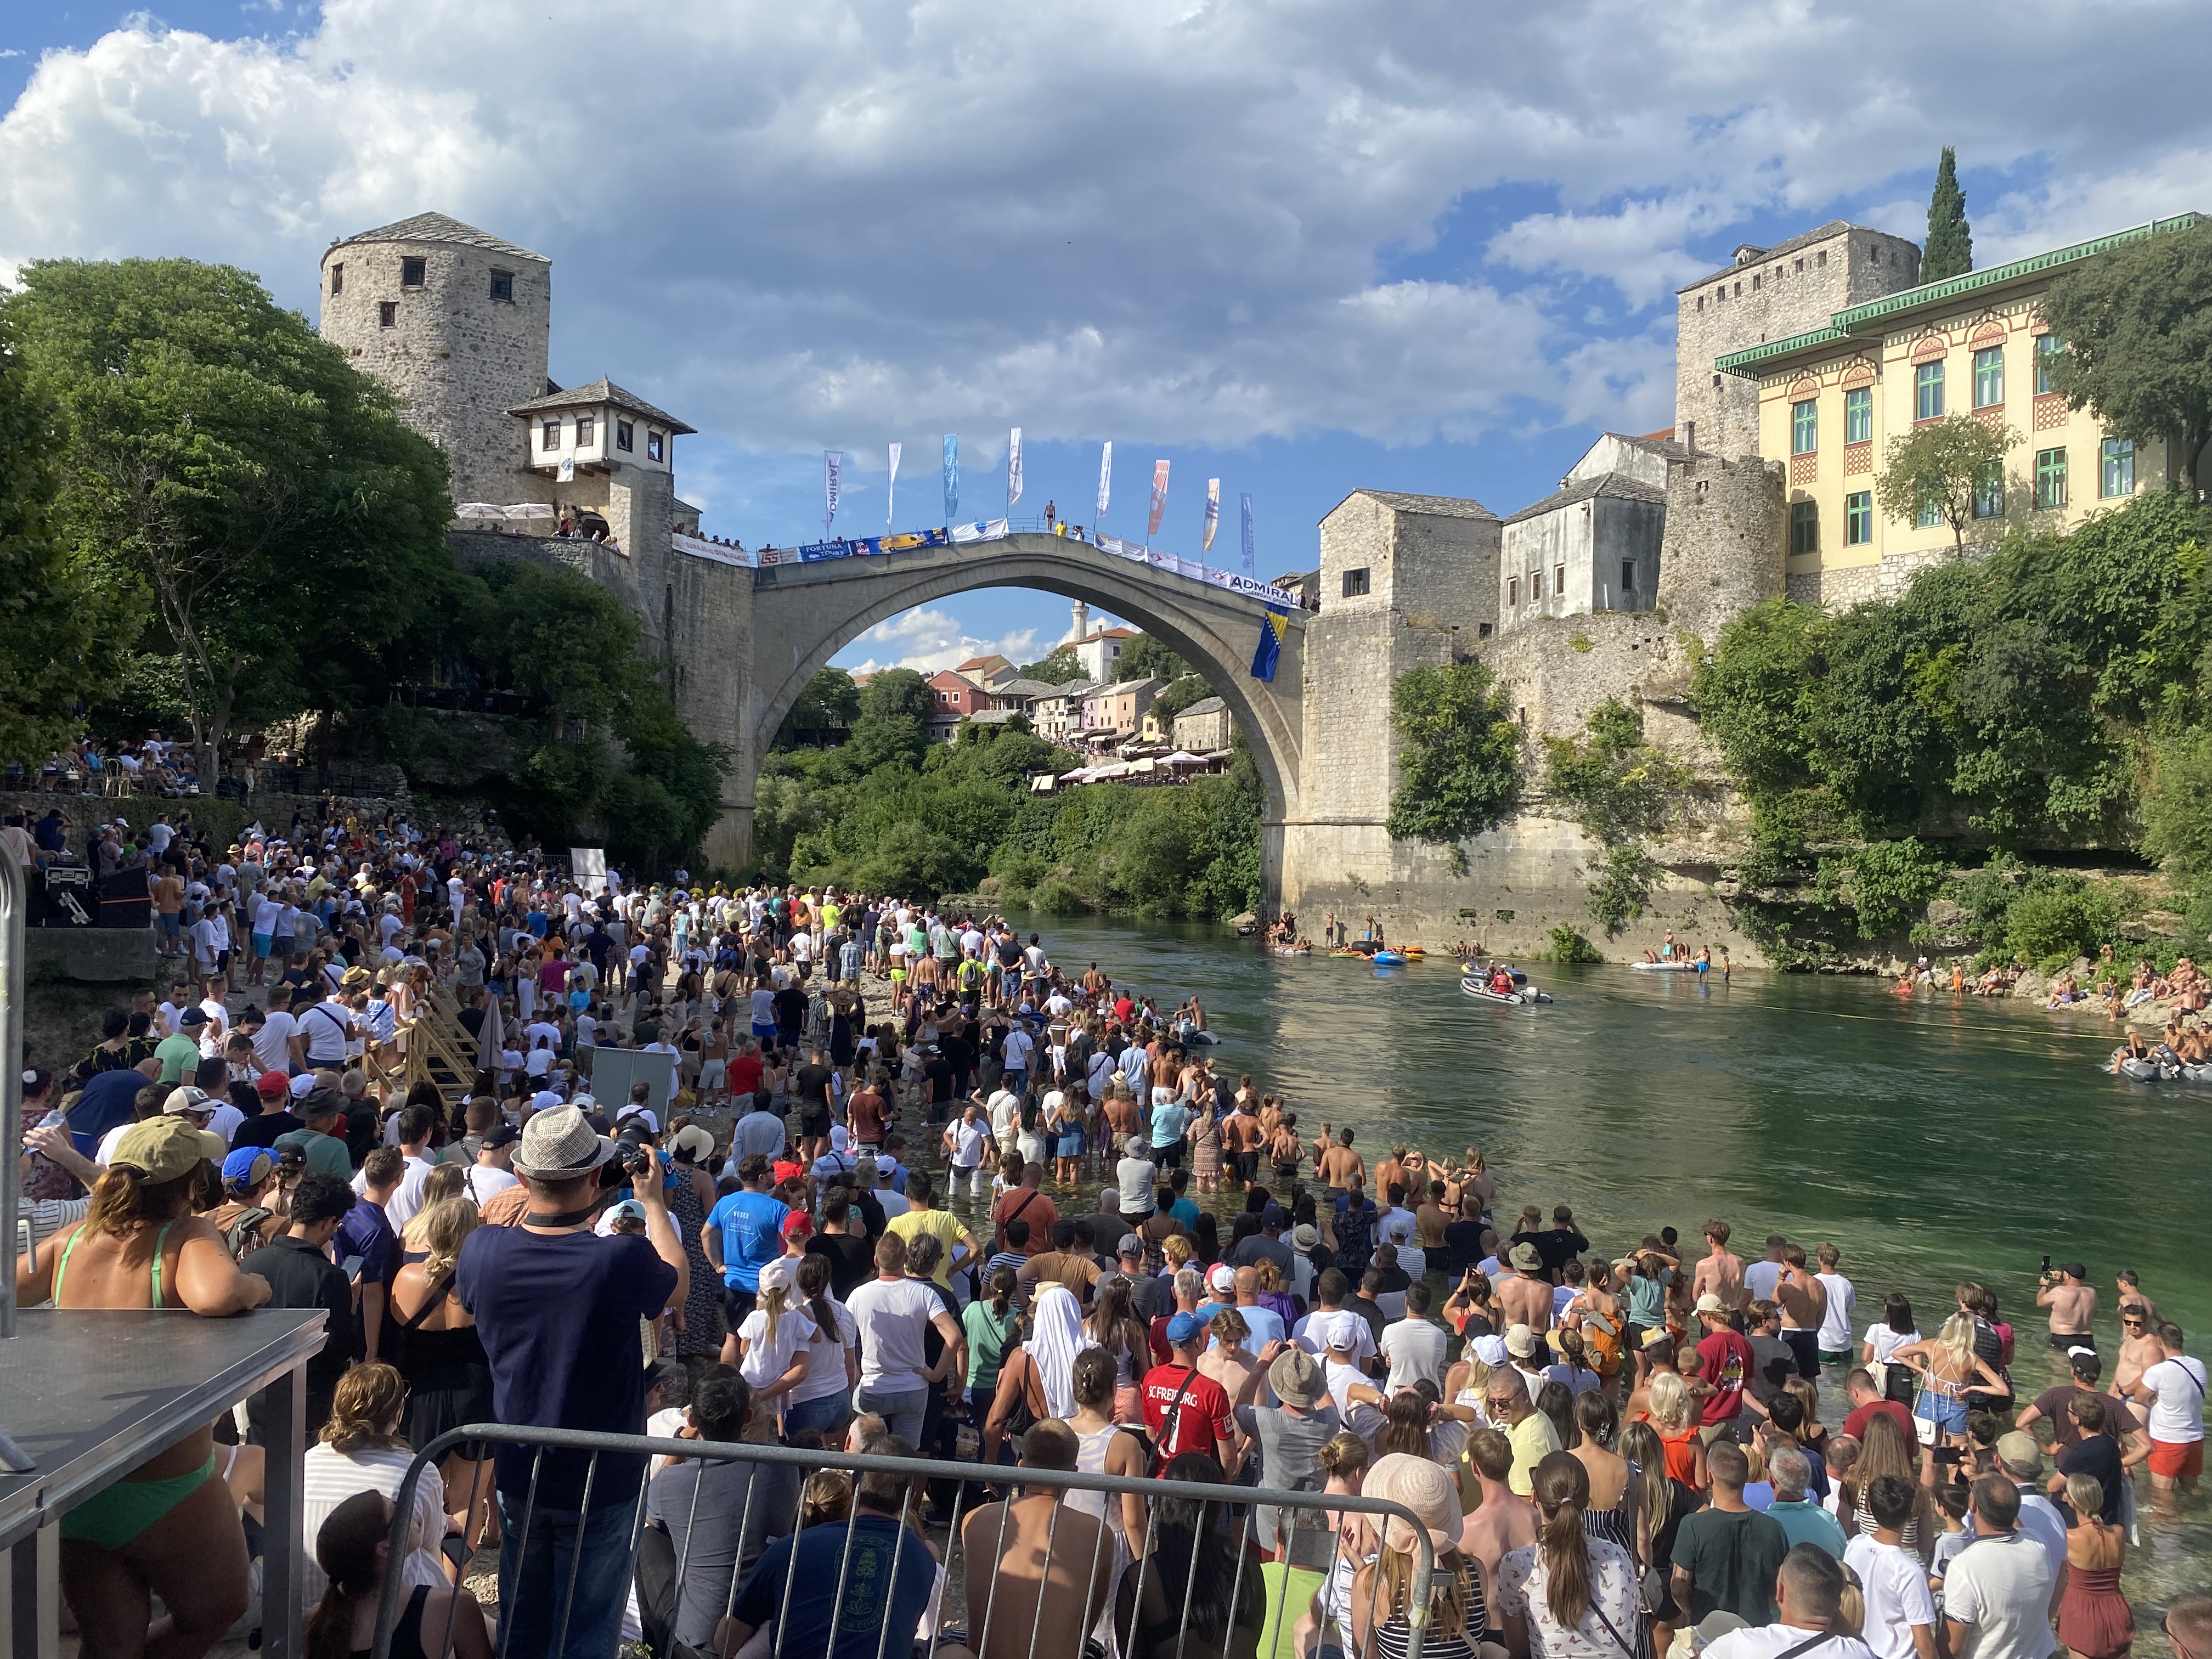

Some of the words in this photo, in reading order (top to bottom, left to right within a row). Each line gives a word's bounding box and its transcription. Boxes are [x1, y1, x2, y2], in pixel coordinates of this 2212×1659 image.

[686, 542, 713, 554] SARAJEVO
[806, 544, 843, 552] FORTUNA
[1231, 576, 1297, 606] ADMIRAL
[1243, 589, 1271, 600] ELECTRONIC
[1149, 1385, 1156, 1398] SC
